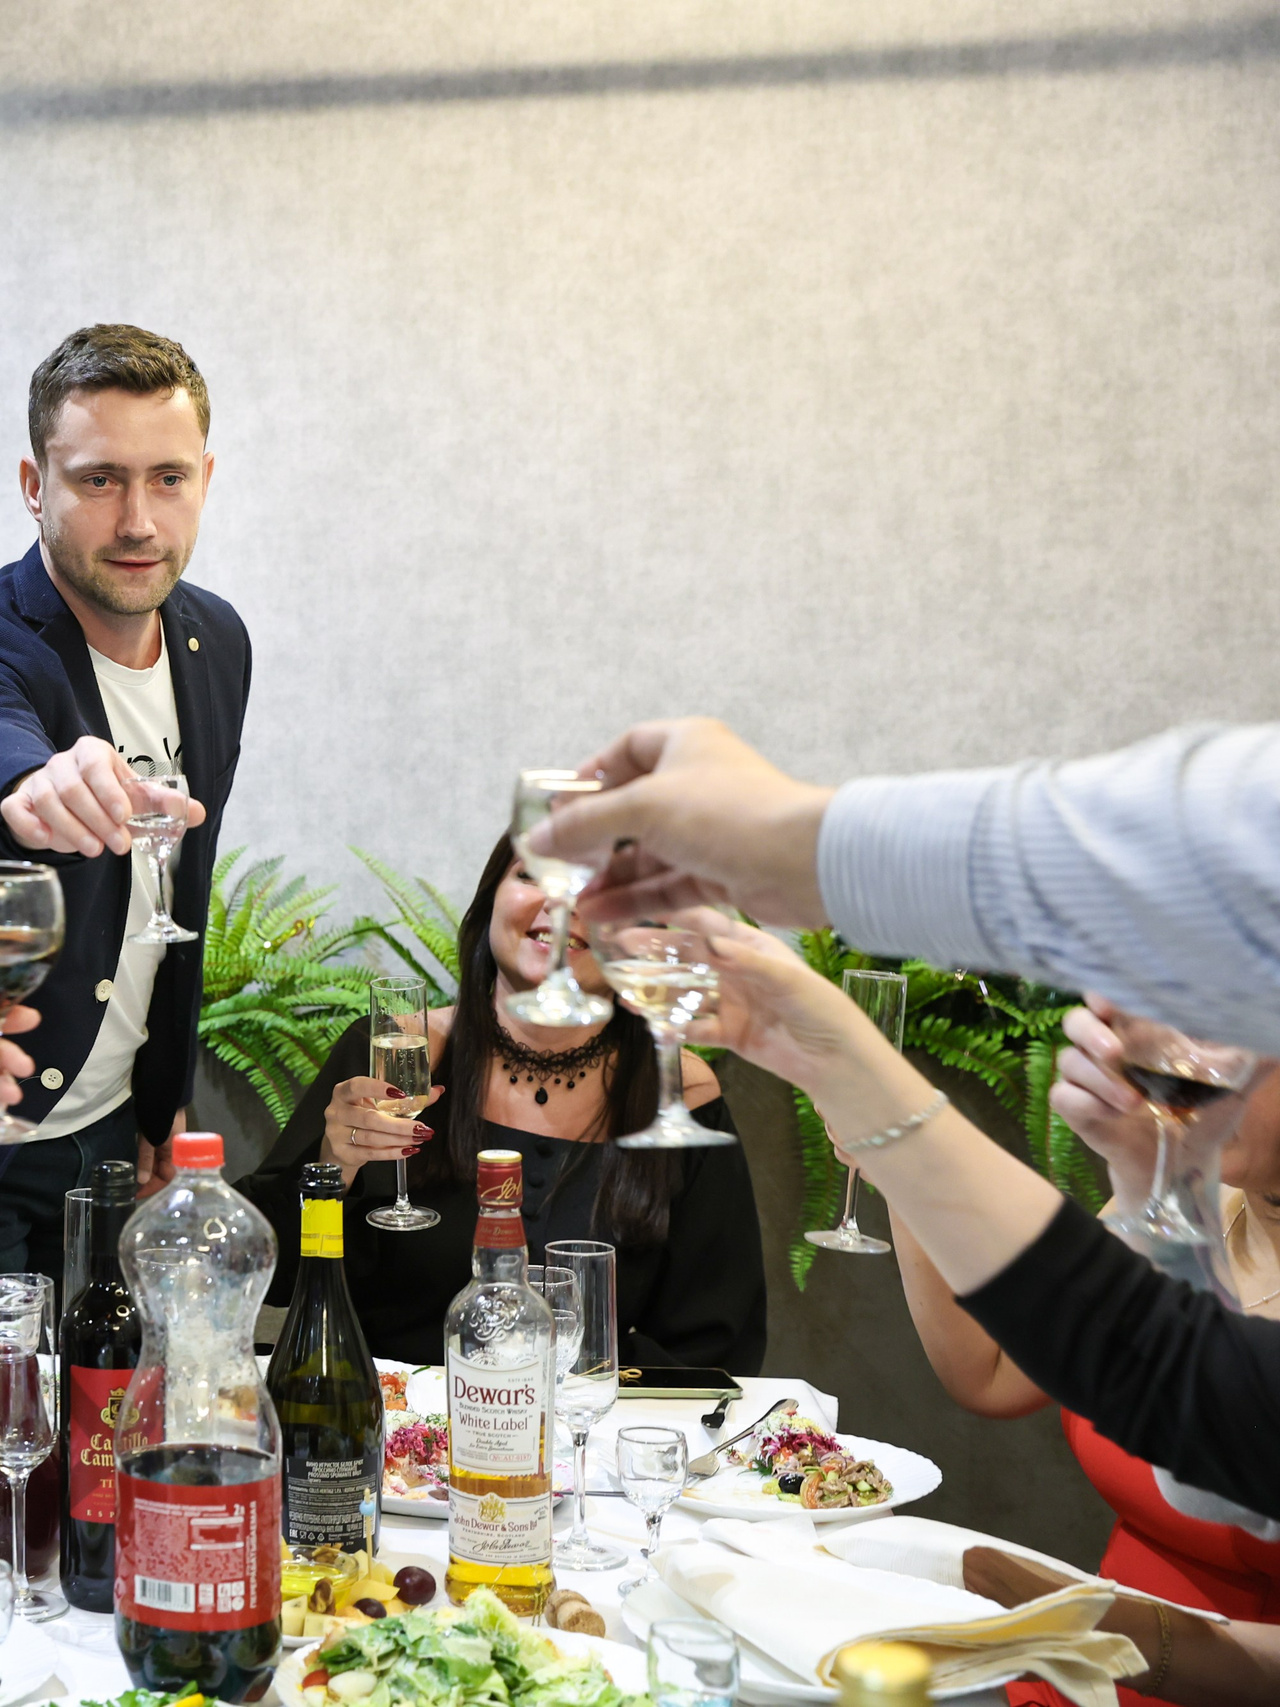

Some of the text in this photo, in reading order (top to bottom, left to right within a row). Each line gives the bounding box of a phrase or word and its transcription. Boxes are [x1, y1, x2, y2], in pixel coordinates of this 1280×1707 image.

[454, 1375, 535, 1406] Dewar's
[471, 1518, 499, 1532] Dewar
[508, 1522, 529, 1532] Sons
